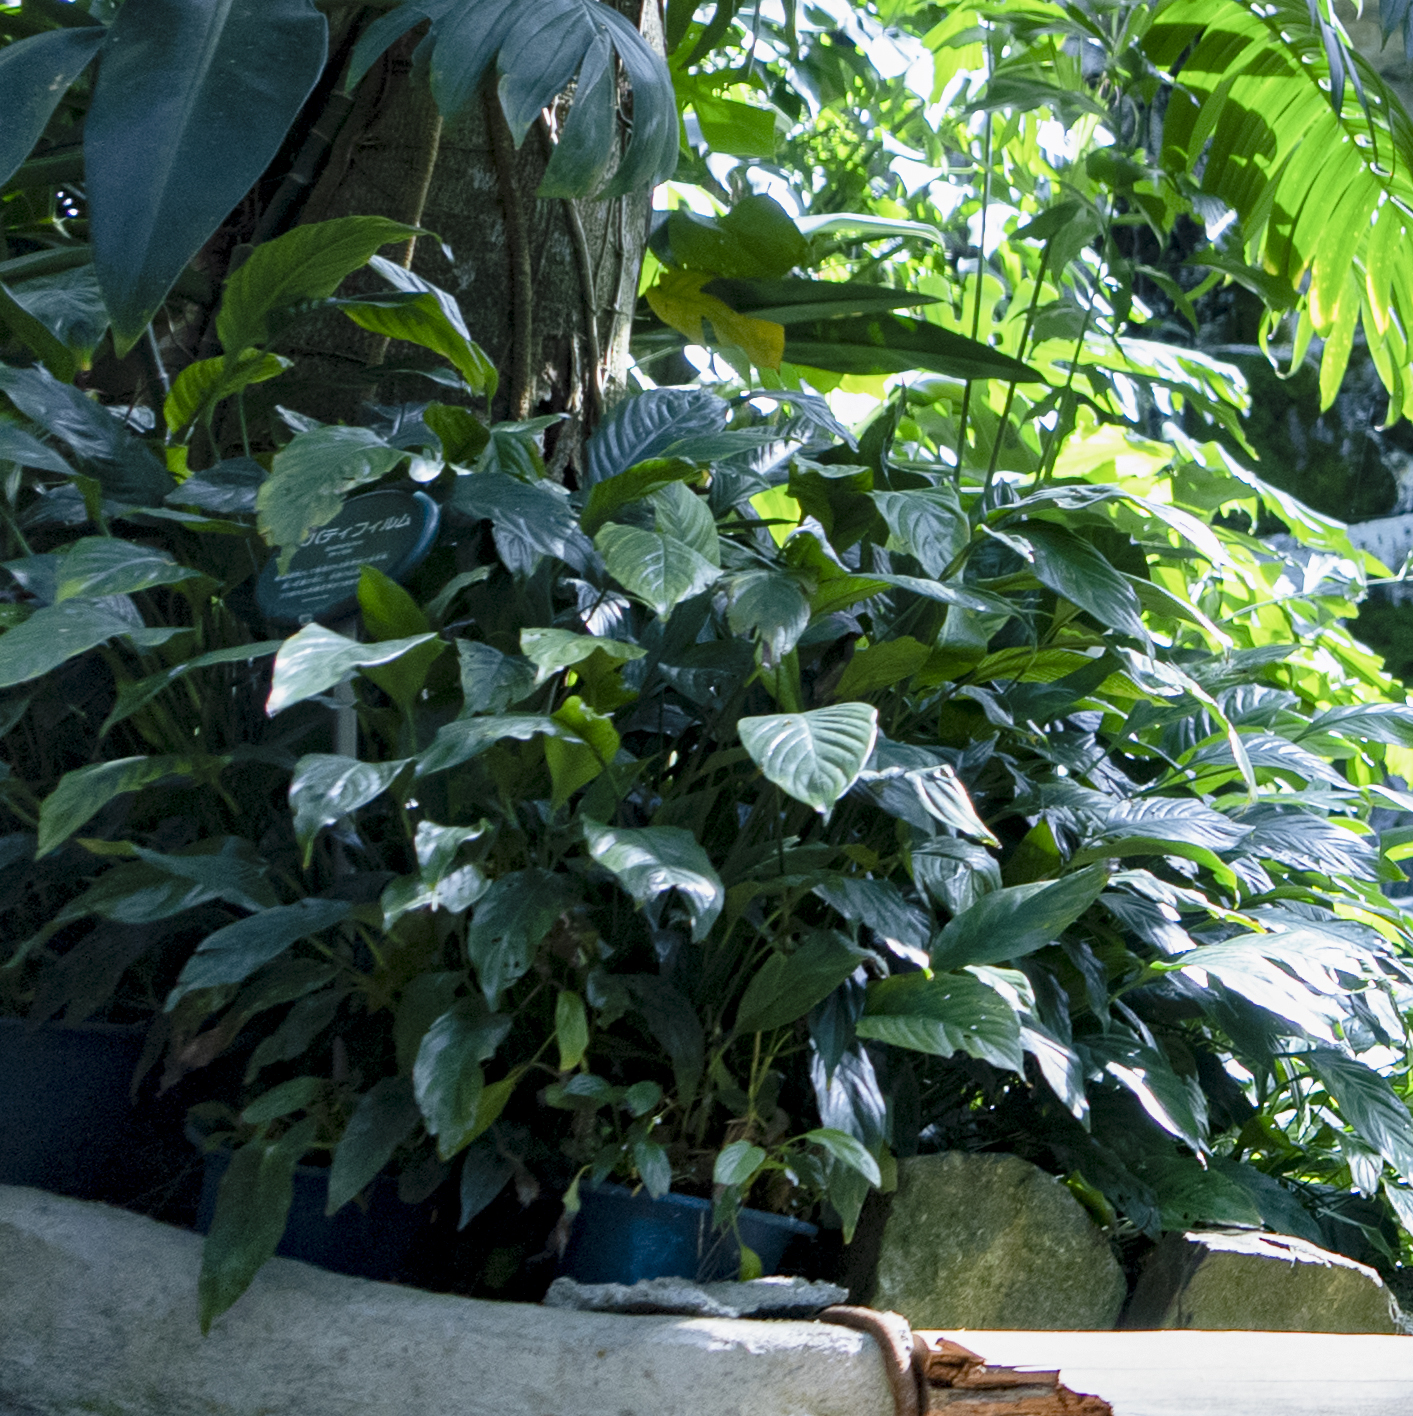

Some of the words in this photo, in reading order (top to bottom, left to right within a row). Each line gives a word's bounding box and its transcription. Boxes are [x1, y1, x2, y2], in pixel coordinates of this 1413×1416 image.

[300, 513, 412, 547] パティフィルム
